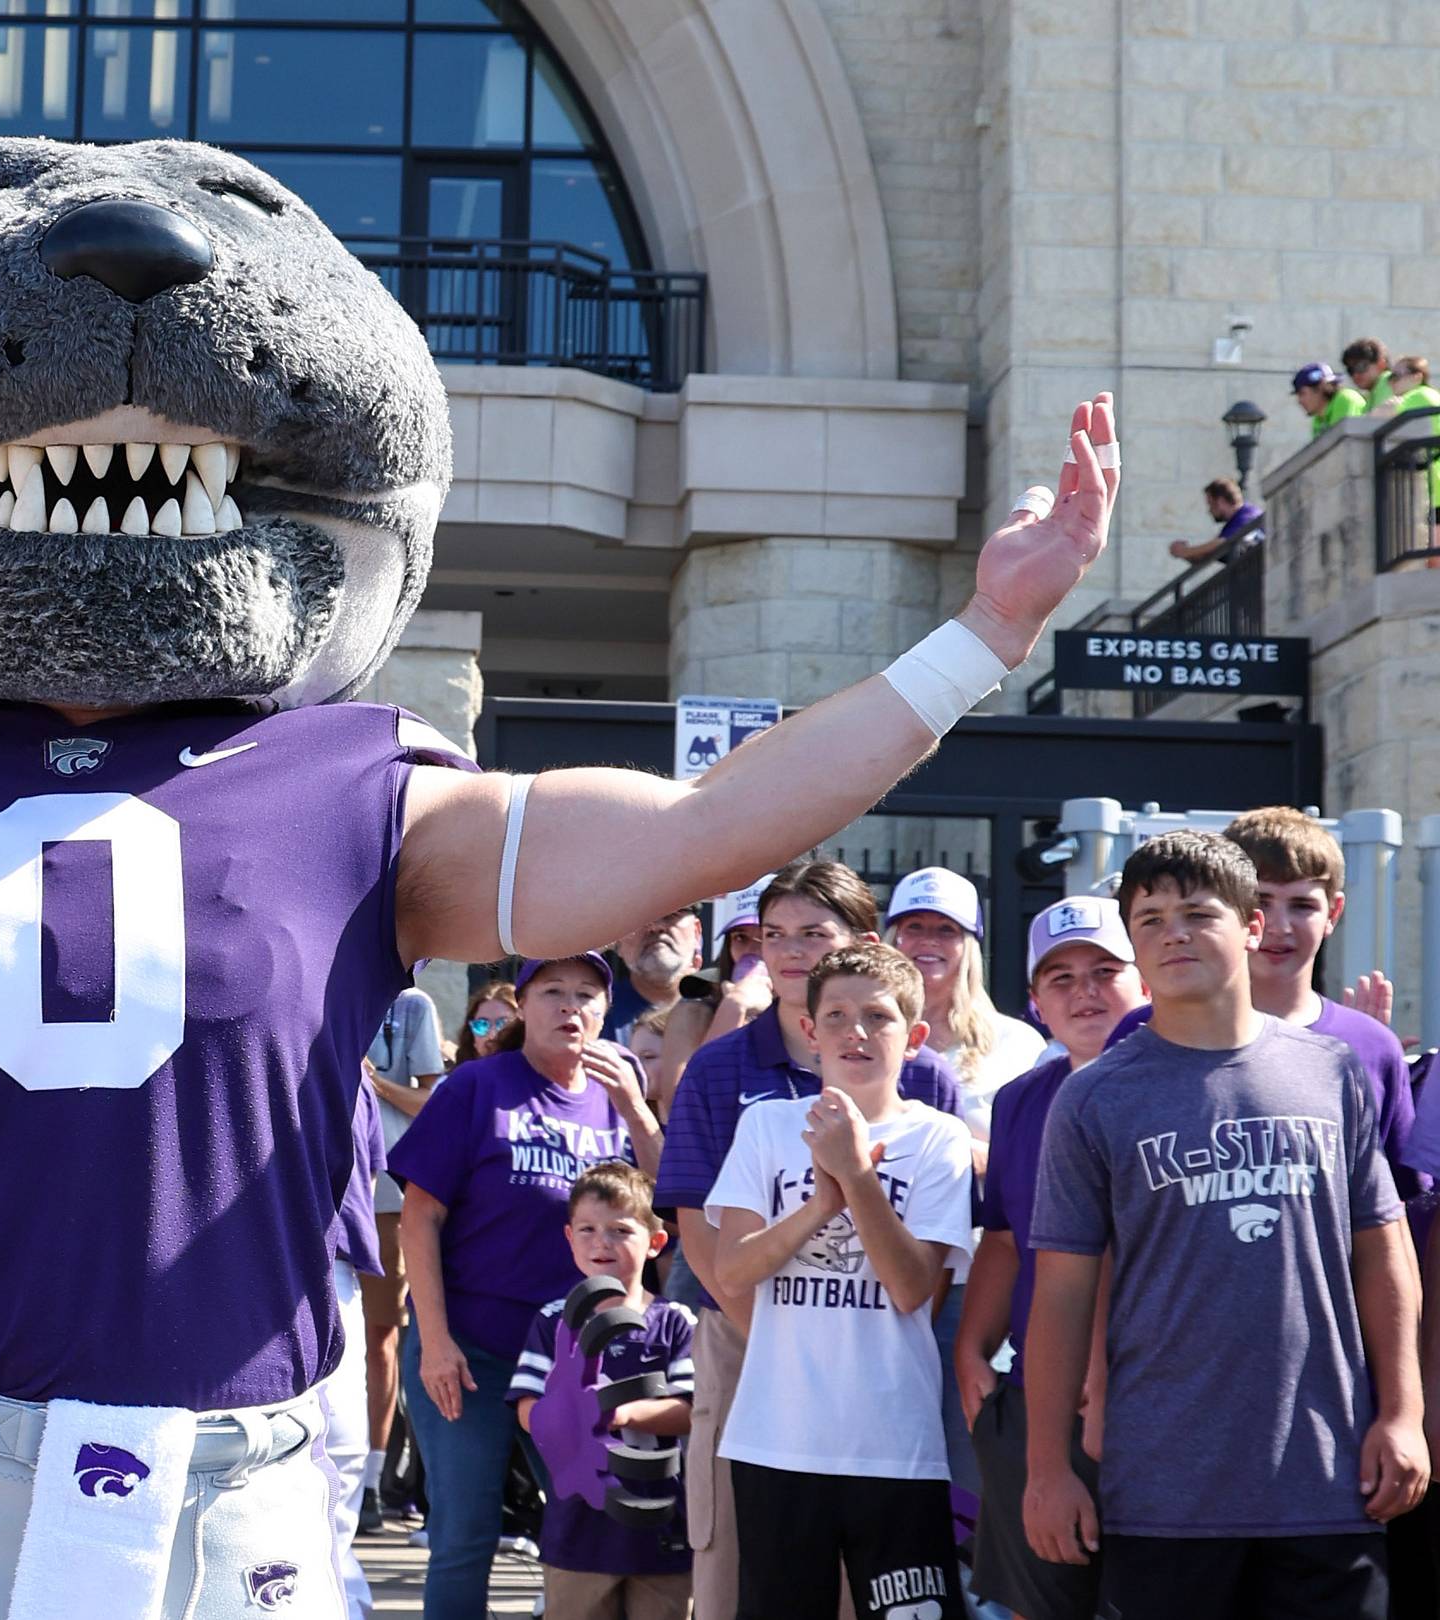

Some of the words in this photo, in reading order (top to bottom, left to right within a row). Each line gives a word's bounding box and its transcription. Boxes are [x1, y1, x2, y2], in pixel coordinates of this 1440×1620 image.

[1086, 637, 1202, 660] EXPRESS
[1210, 642, 1279, 663] GATE
[1123, 664, 1163, 684] NO
[1171, 666, 1242, 686] BAGS
[686, 711, 719, 719] PLEASE
[511, 1144, 588, 1181] WILDC
[1137, 1116, 1339, 1191] K-STATE
[771, 1167, 909, 1222] K-SE
[1183, 1167, 1317, 1206] WILDCATS
[773, 1276, 887, 1311] FOOTBALL
